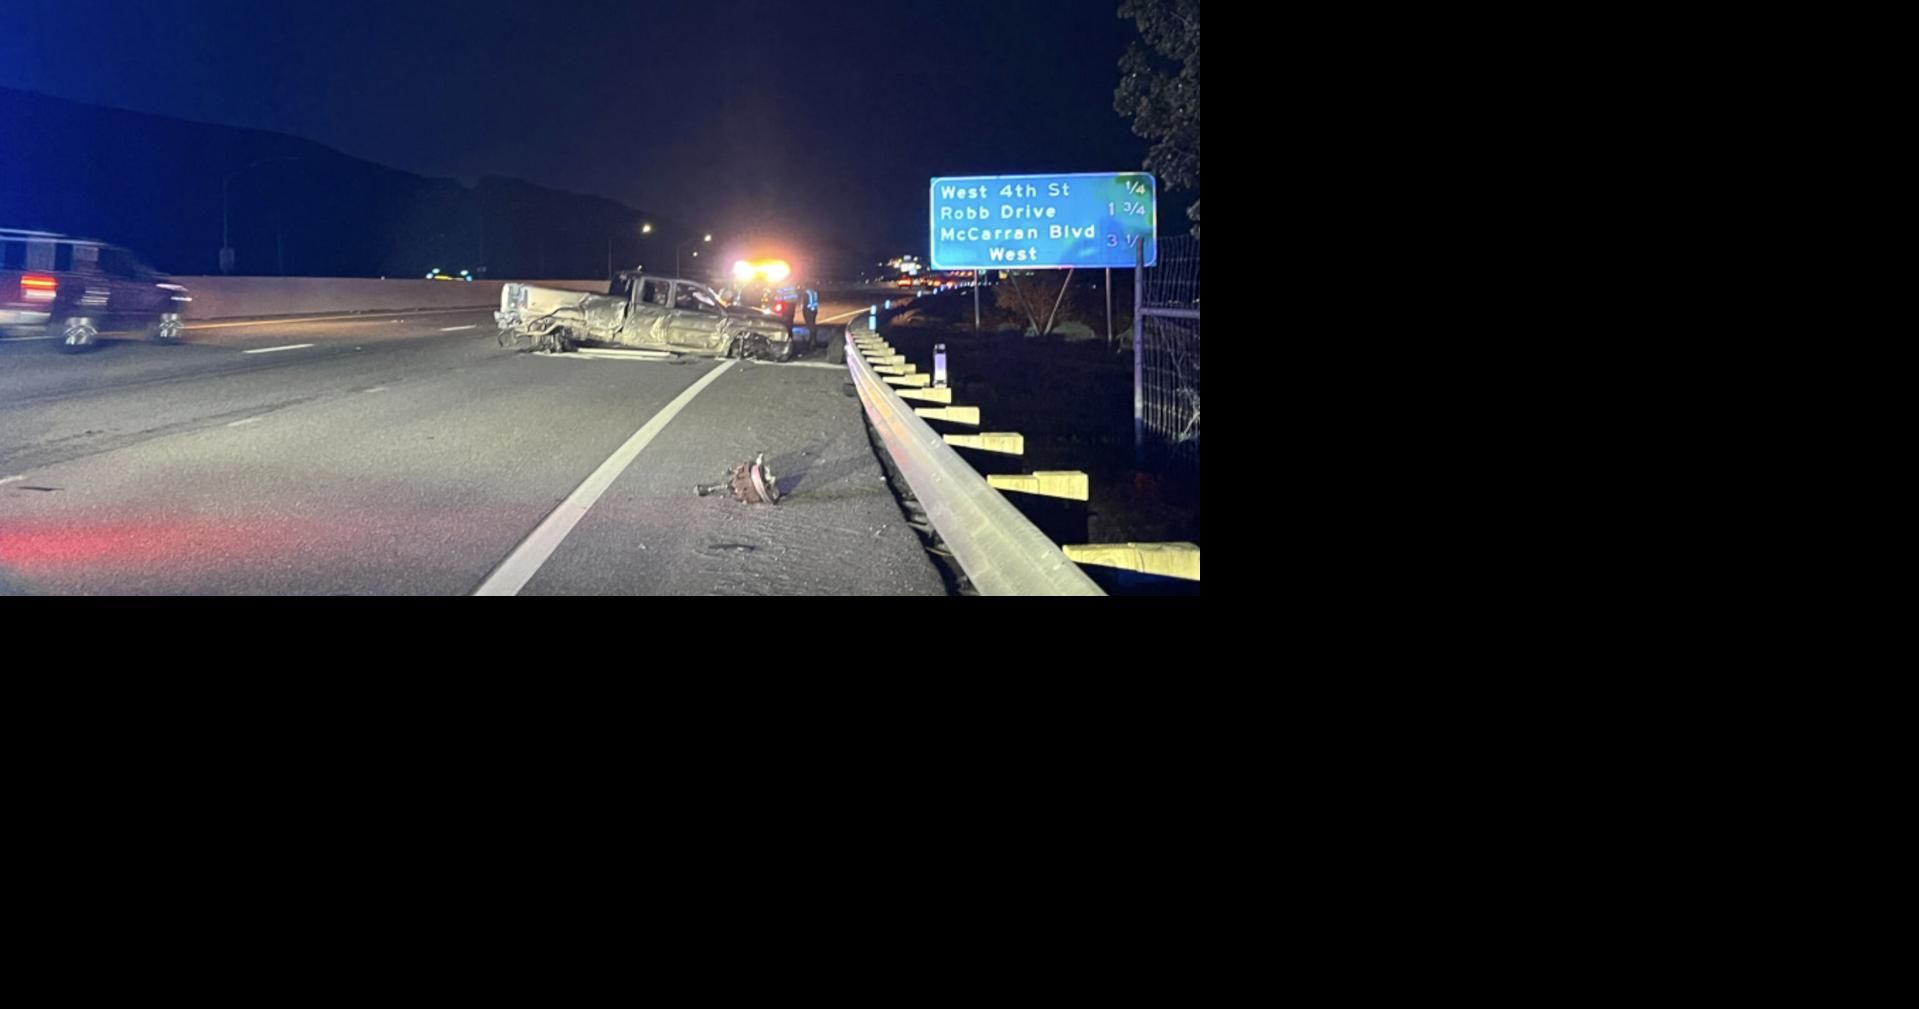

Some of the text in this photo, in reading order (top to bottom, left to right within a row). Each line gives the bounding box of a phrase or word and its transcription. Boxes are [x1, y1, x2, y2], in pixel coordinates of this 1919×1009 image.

[940, 180, 1146, 200] West 4th St 1/4
[940, 201, 1146, 220] Robb Drive 1 3/4
[940, 224, 1140, 249] McCarran Blvd 3 1/
[988, 246, 1038, 262] West
